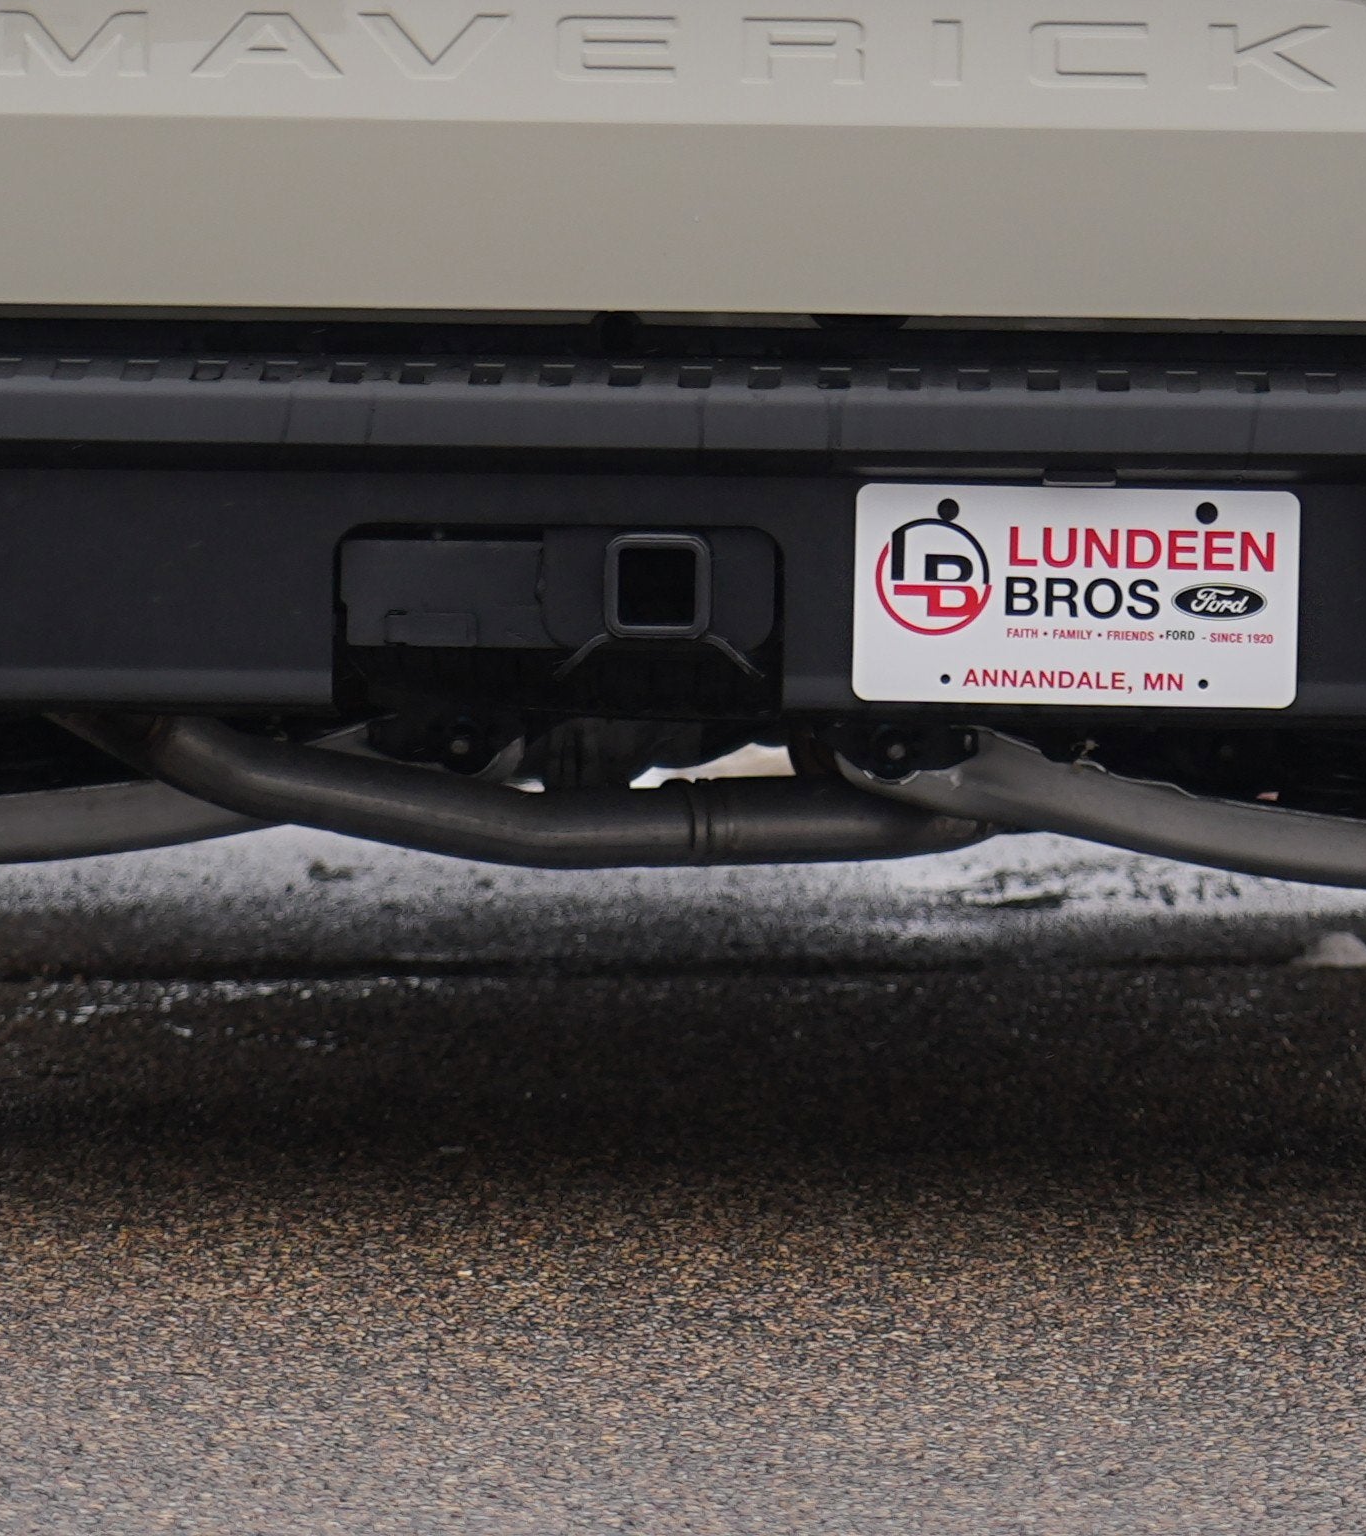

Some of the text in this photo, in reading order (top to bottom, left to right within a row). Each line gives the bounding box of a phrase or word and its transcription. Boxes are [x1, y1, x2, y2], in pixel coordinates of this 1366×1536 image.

[1008, 525, 1276, 573] LUNDEEN
[1004, 576, 1250, 620] BROS Ford
[1006, 627, 1274, 644] FAITH FAMILY FRIENDS FORD SINCE 1920
[962, 668, 1184, 694] ANNANDALE, MN
